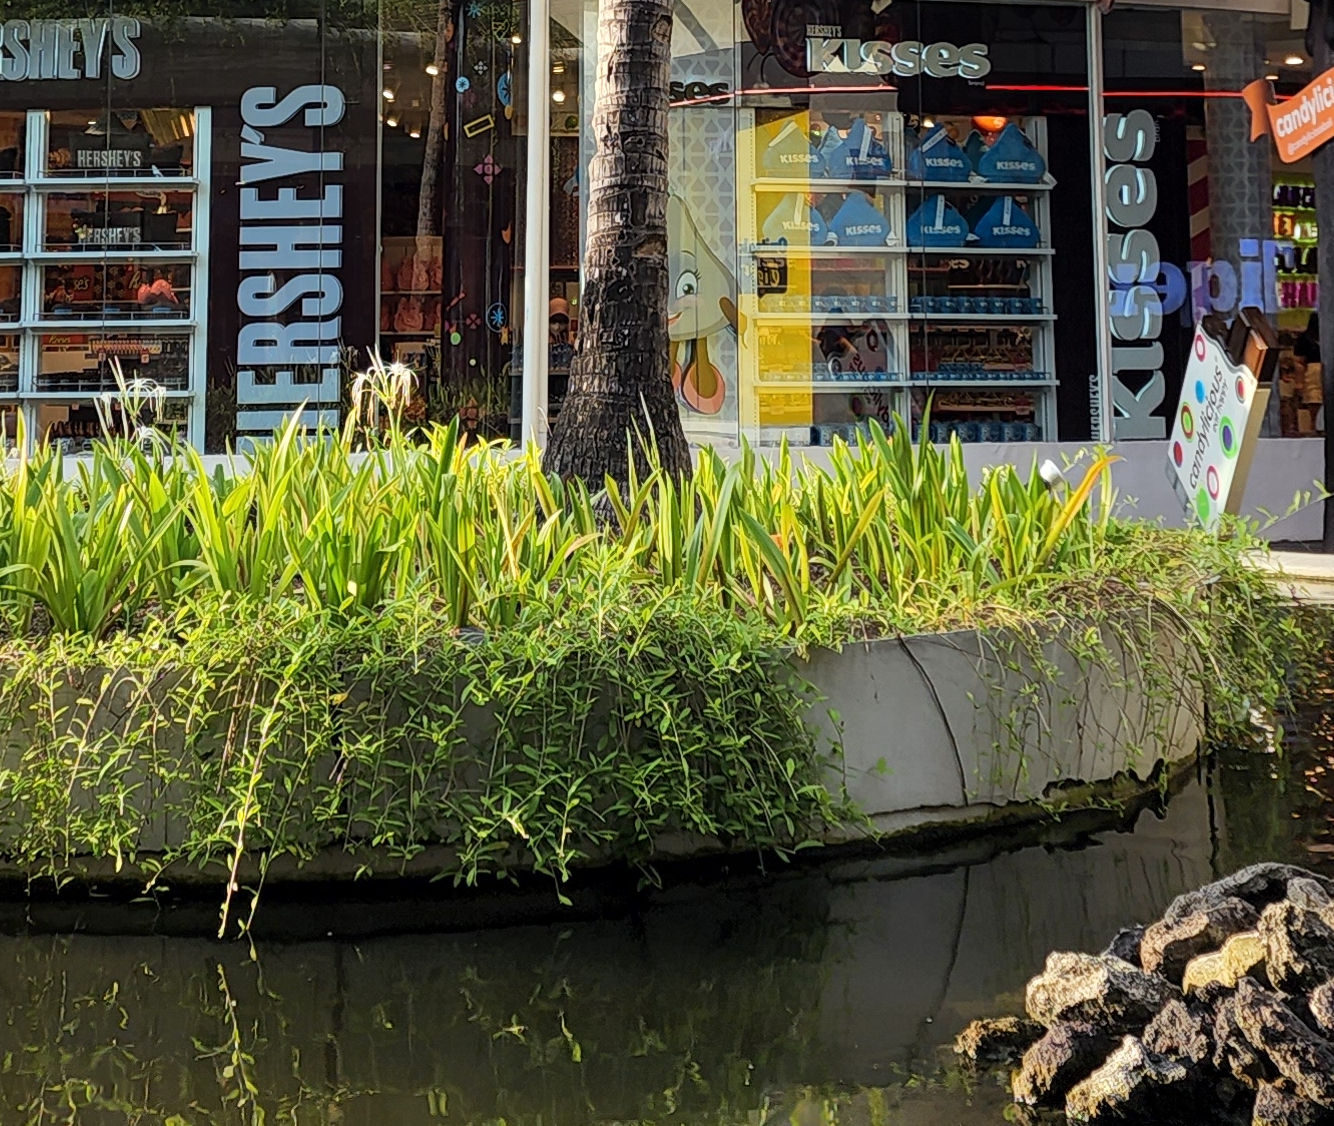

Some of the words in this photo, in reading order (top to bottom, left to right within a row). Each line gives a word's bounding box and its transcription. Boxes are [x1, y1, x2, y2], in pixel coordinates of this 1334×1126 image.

[76, 149, 141, 168] HERSHEY'S
[236, 85, 346, 454] HERSHEY'S
[1189, 367, 1224, 490] candylicious
